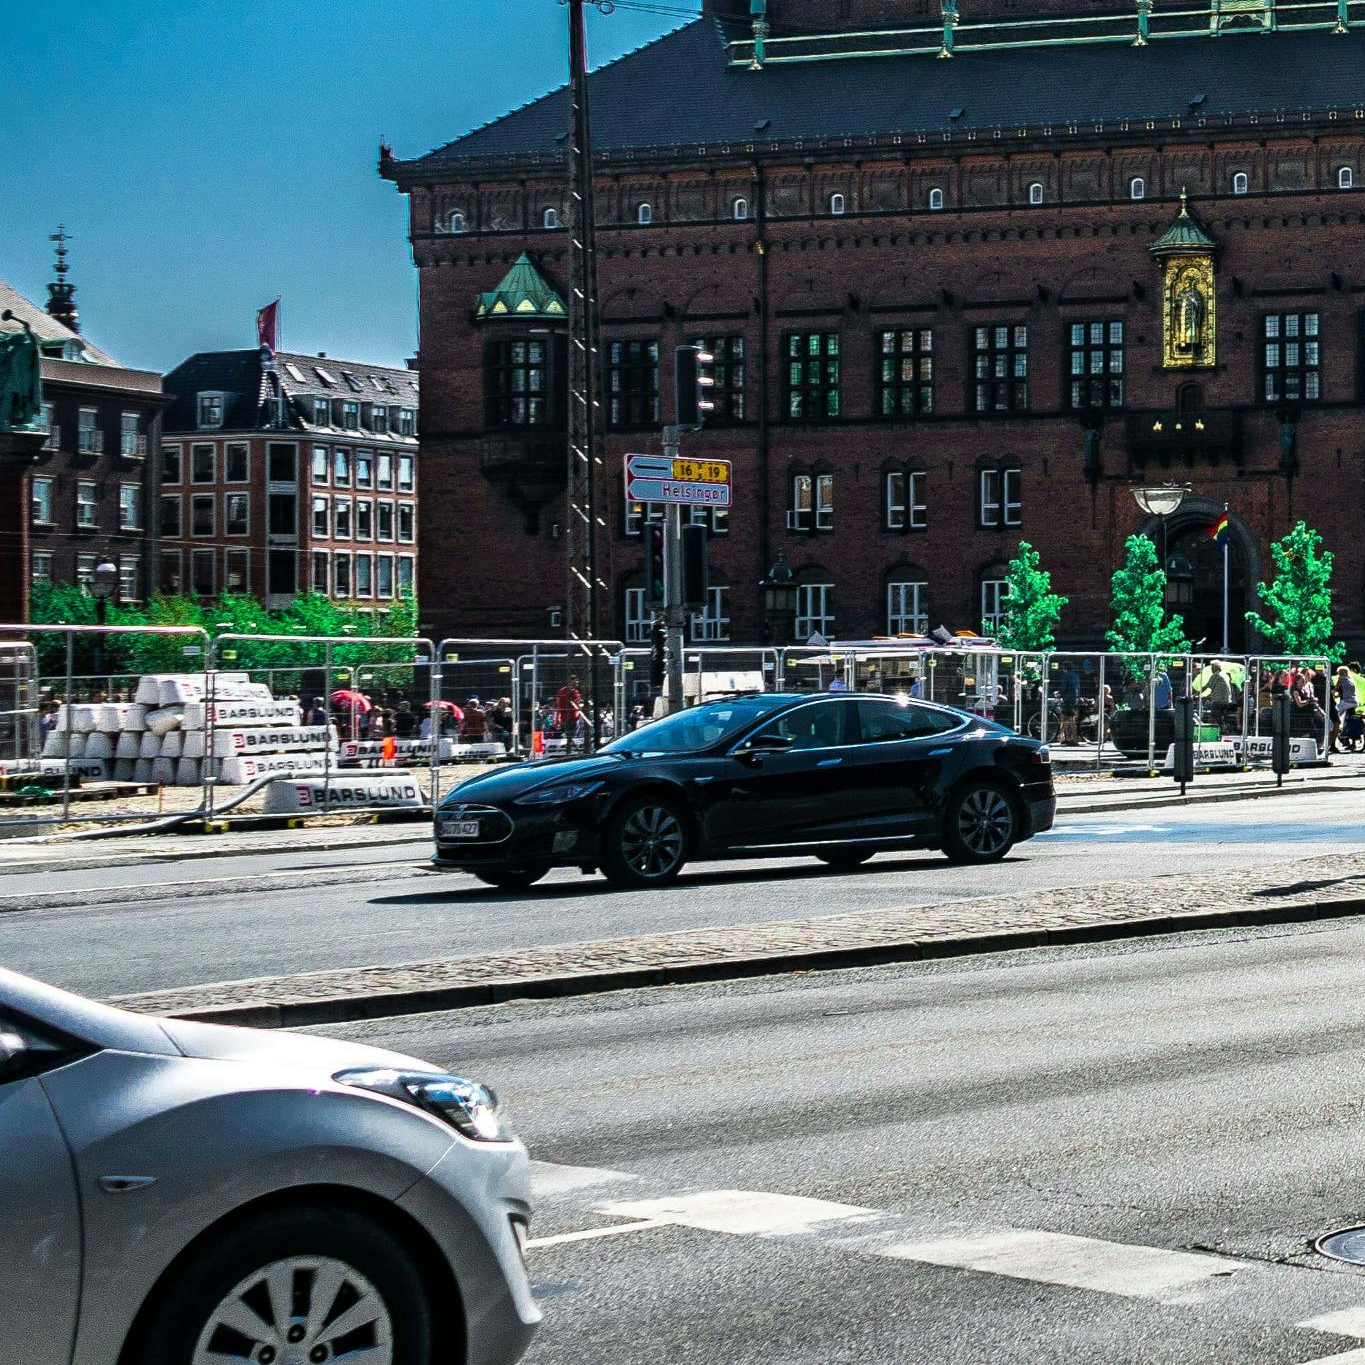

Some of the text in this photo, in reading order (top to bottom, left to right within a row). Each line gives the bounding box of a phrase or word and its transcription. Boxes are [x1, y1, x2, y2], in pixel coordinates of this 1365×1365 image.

[680, 464, 720, 478] 16 19
[662, 484, 725, 502] Helsingør
[218, 707, 294, 719] BARSLUND
[247, 732, 332, 745] BARSLUND
[1193, 748, 1235, 760] BARSLUND
[257, 759, 332, 773] BARSLUND
[314, 785, 416, 803] BARSLUND
